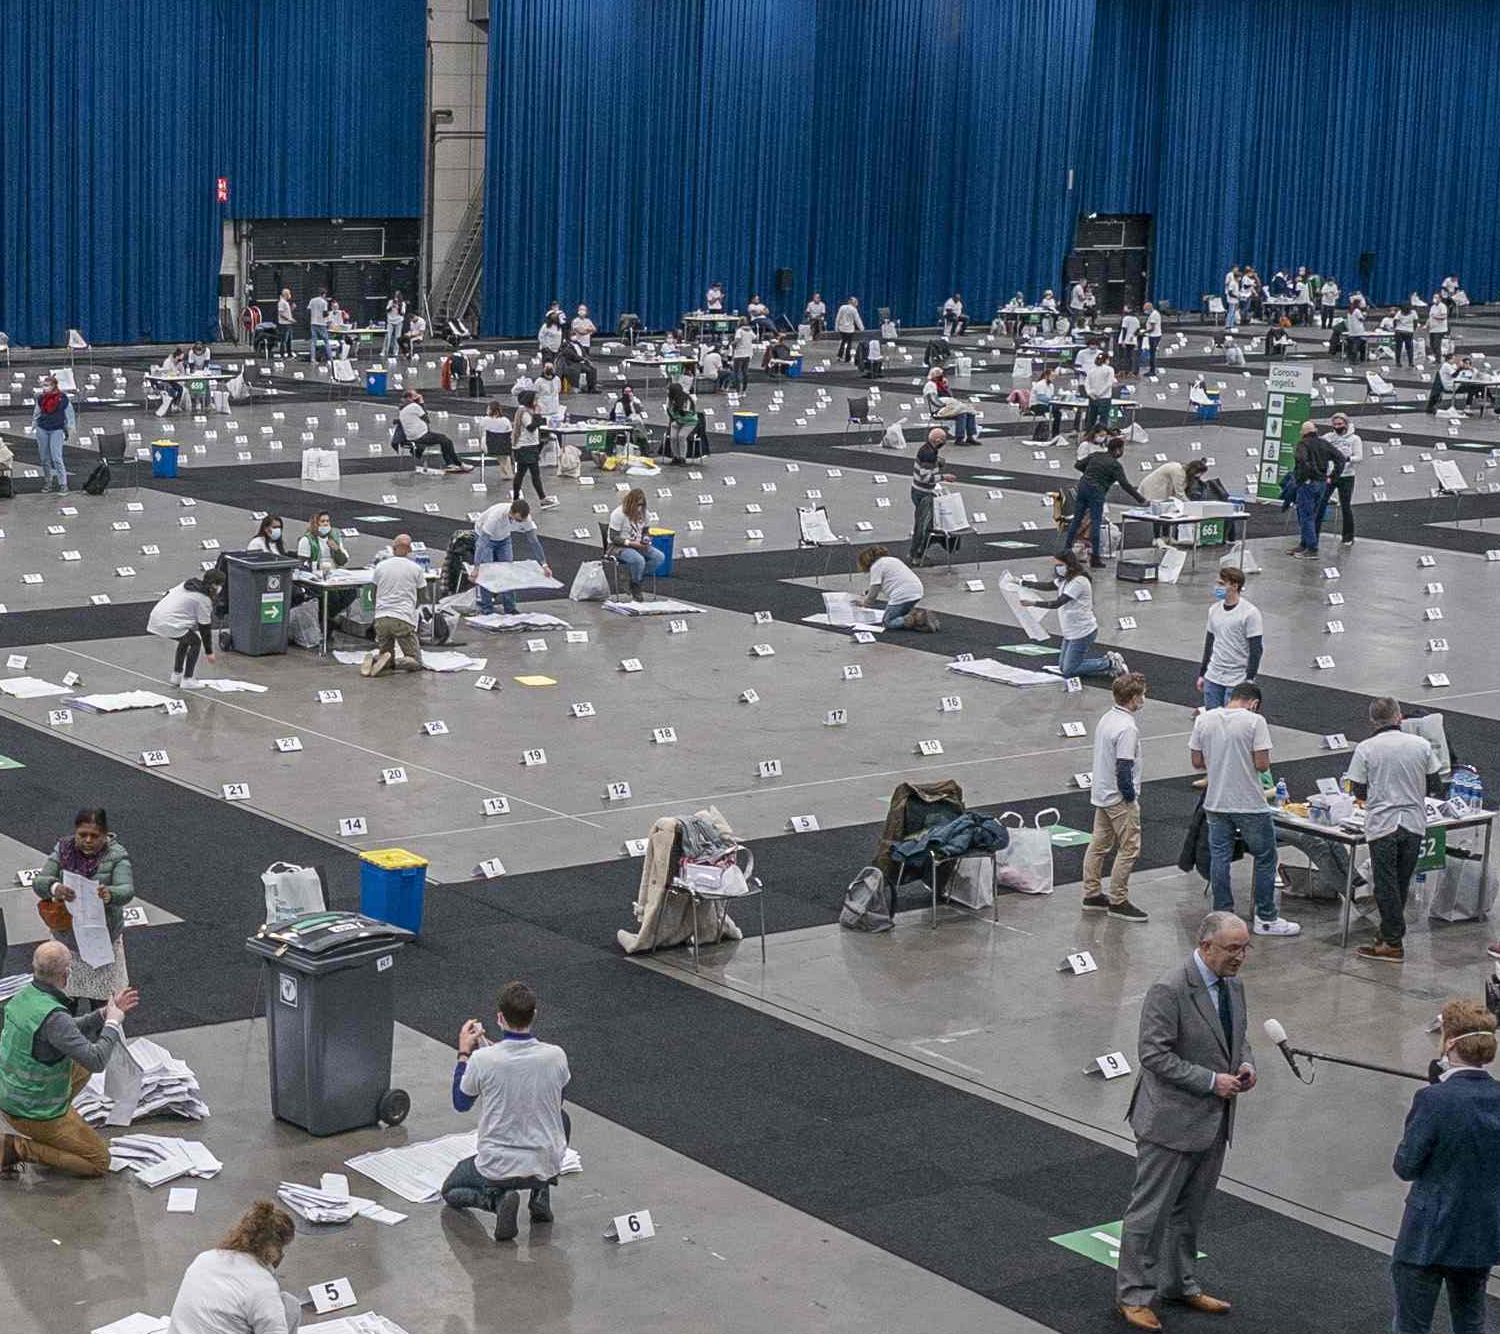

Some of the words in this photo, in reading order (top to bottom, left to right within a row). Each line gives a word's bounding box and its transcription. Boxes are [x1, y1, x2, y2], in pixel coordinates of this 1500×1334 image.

[1271, 368, 1301, 378] Corona-
[170, 702, 182, 710] 34
[54, 711, 68, 720] 35
[832, 711, 843, 720] 17
[148, 753, 163, 761] 28
[529, 750, 541, 760] 19
[764, 762, 776, 772] 11
[388, 770, 401, 779] 20
[1083, 775, 1091, 783] 3
[229, 785, 243, 795] 21
[613, 784, 626, 794] 12
[489, 800, 504, 810] 13
[346, 819, 361, 830] 14
[801, 818, 809, 827] 5
[635, 841, 644, 850] 6
[487, 861, 494, 871] 7
[1077, 955, 1086, 966] 3
[1107, 1056, 1118, 1069] 9
[629, 1215, 640, 1232] 6
[325, 1283, 339, 1300] 5
